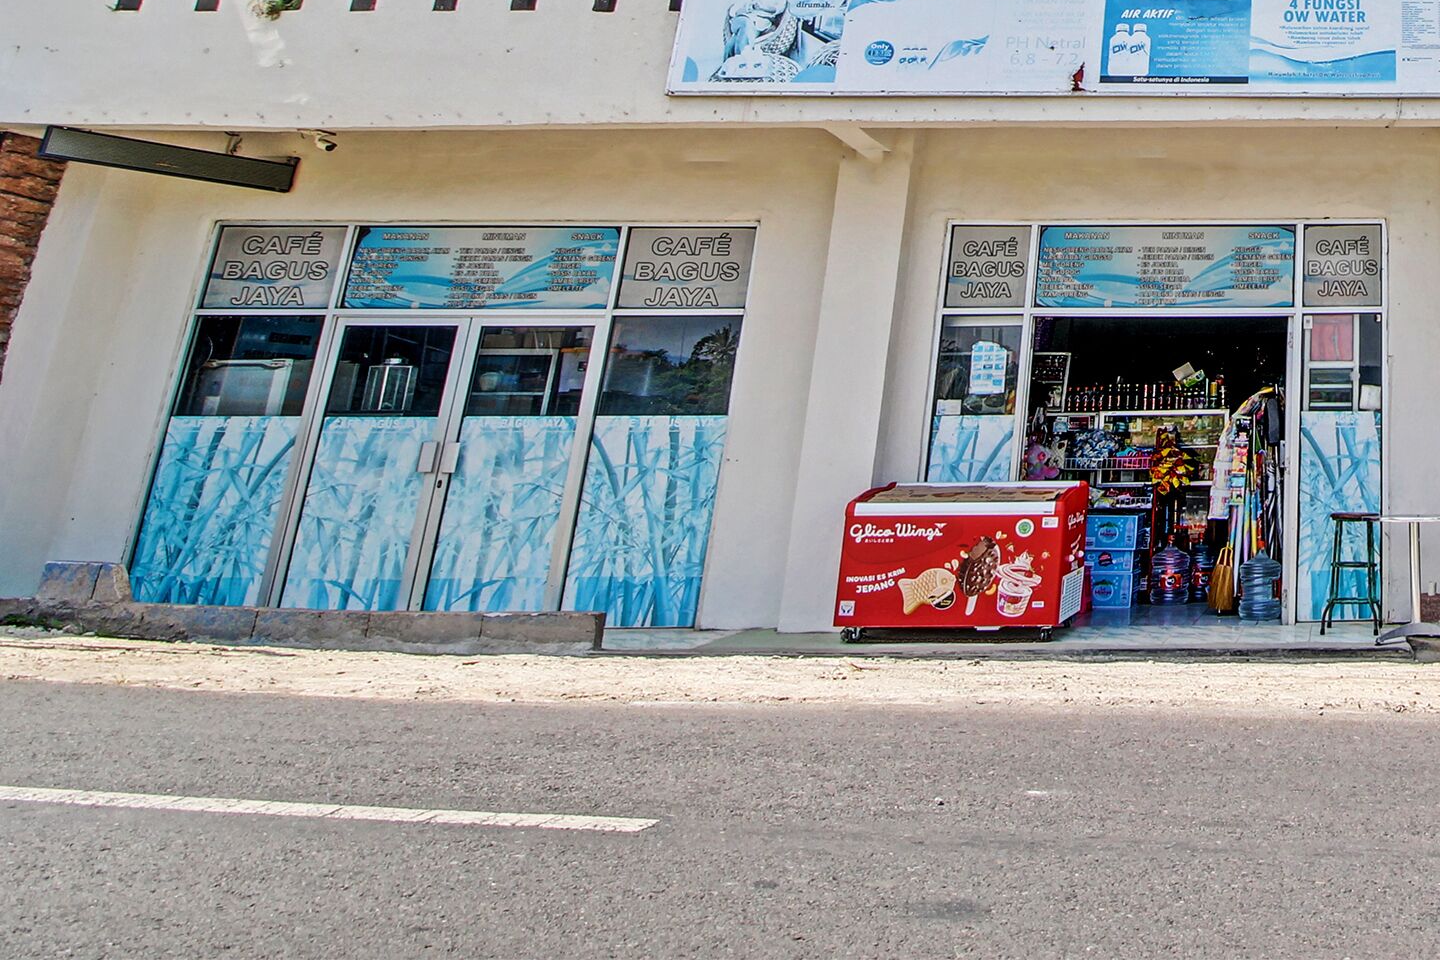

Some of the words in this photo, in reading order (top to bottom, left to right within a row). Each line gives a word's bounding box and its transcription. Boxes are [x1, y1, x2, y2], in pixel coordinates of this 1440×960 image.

[1121, 9, 1141, 19] AIR
[1142, 9, 1175, 19] AKTIF
[1283, 10, 1310, 22] OW
[1315, 10, 1366, 23] WATER
[1006, 37, 1029, 49] PH
[1036, 37, 1086, 49] Netral
[242, 231, 323, 255] CAFÉ
[571, 233, 604, 241] SNACK
[1247, 231, 1280, 240] SNACK
[652, 232, 732, 256] CAFÉ
[963, 236, 1018, 257] CAFÉ
[1315, 236, 1370, 255] CAFÉ
[222, 261, 329, 280] BAGUS
[634, 262, 740, 281] BAGUS
[953, 261, 1025, 277] BAGUS
[1307, 260, 1378, 276] BAGUS
[231, 286, 304, 306] JAYA
[960, 282, 1012, 298] JAYA
[1317, 280, 1368, 296] JAYA
[644, 287, 719, 307] JAYA
[850, 523, 895, 543] Glico
[895, 523, 944, 542] Wings
[845, 575, 876, 583] INOVASI
[876, 573, 887, 581] ES
[887, 567, 906, 579] KRIM
[855, 578, 896, 594] JEPANG
